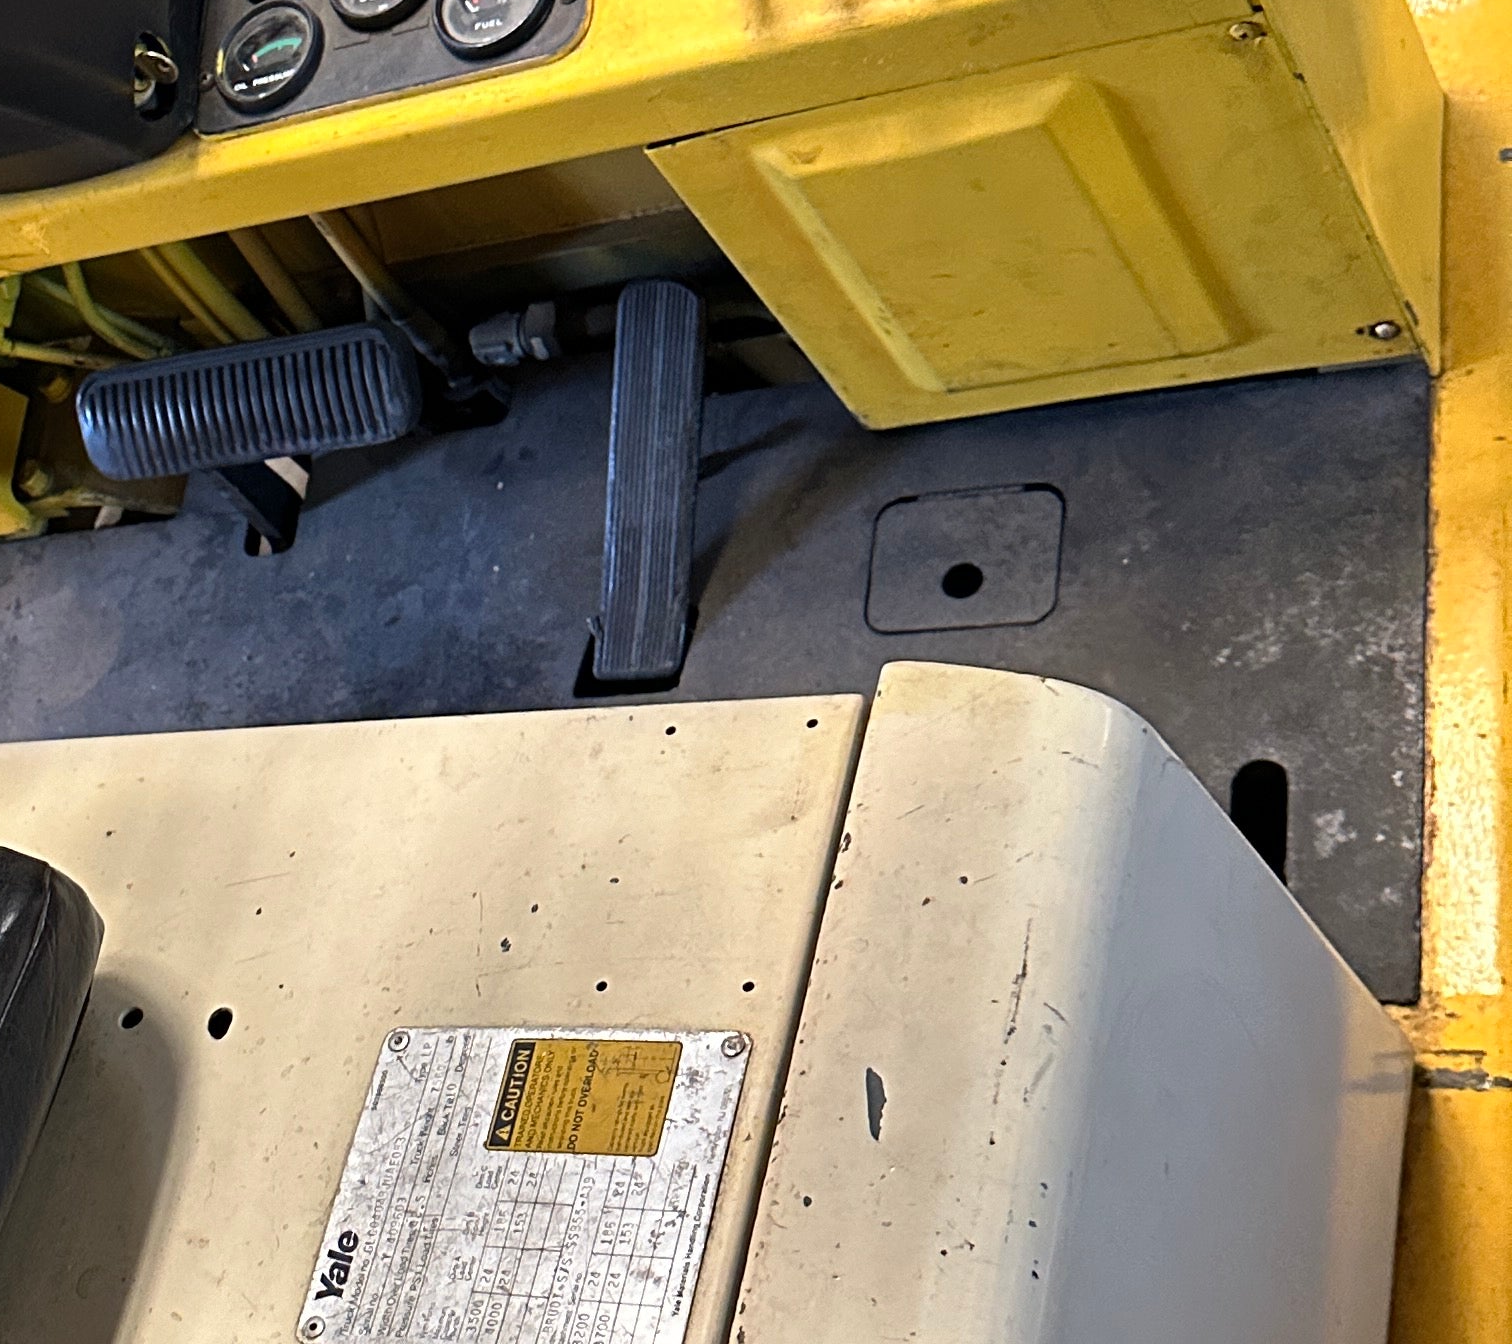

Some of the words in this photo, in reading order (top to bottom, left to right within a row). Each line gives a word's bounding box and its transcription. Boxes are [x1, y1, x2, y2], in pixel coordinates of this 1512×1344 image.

[474, 17, 503, 31] FUEL
[542, 1049, 557, 1073] ONLY
[499, 1048, 532, 1121] CAUTION
[575, 1048, 601, 1107] OVERLOAD
[528, 1074, 550, 1127] MECHANICS
[512, 1109, 531, 1148] TRAINED
[569, 1109, 586, 1132] NOT
[522, 1128, 537, 1148] AND
[565, 1133, 580, 1150] DO
[312, 1228, 362, 1302] Yale
